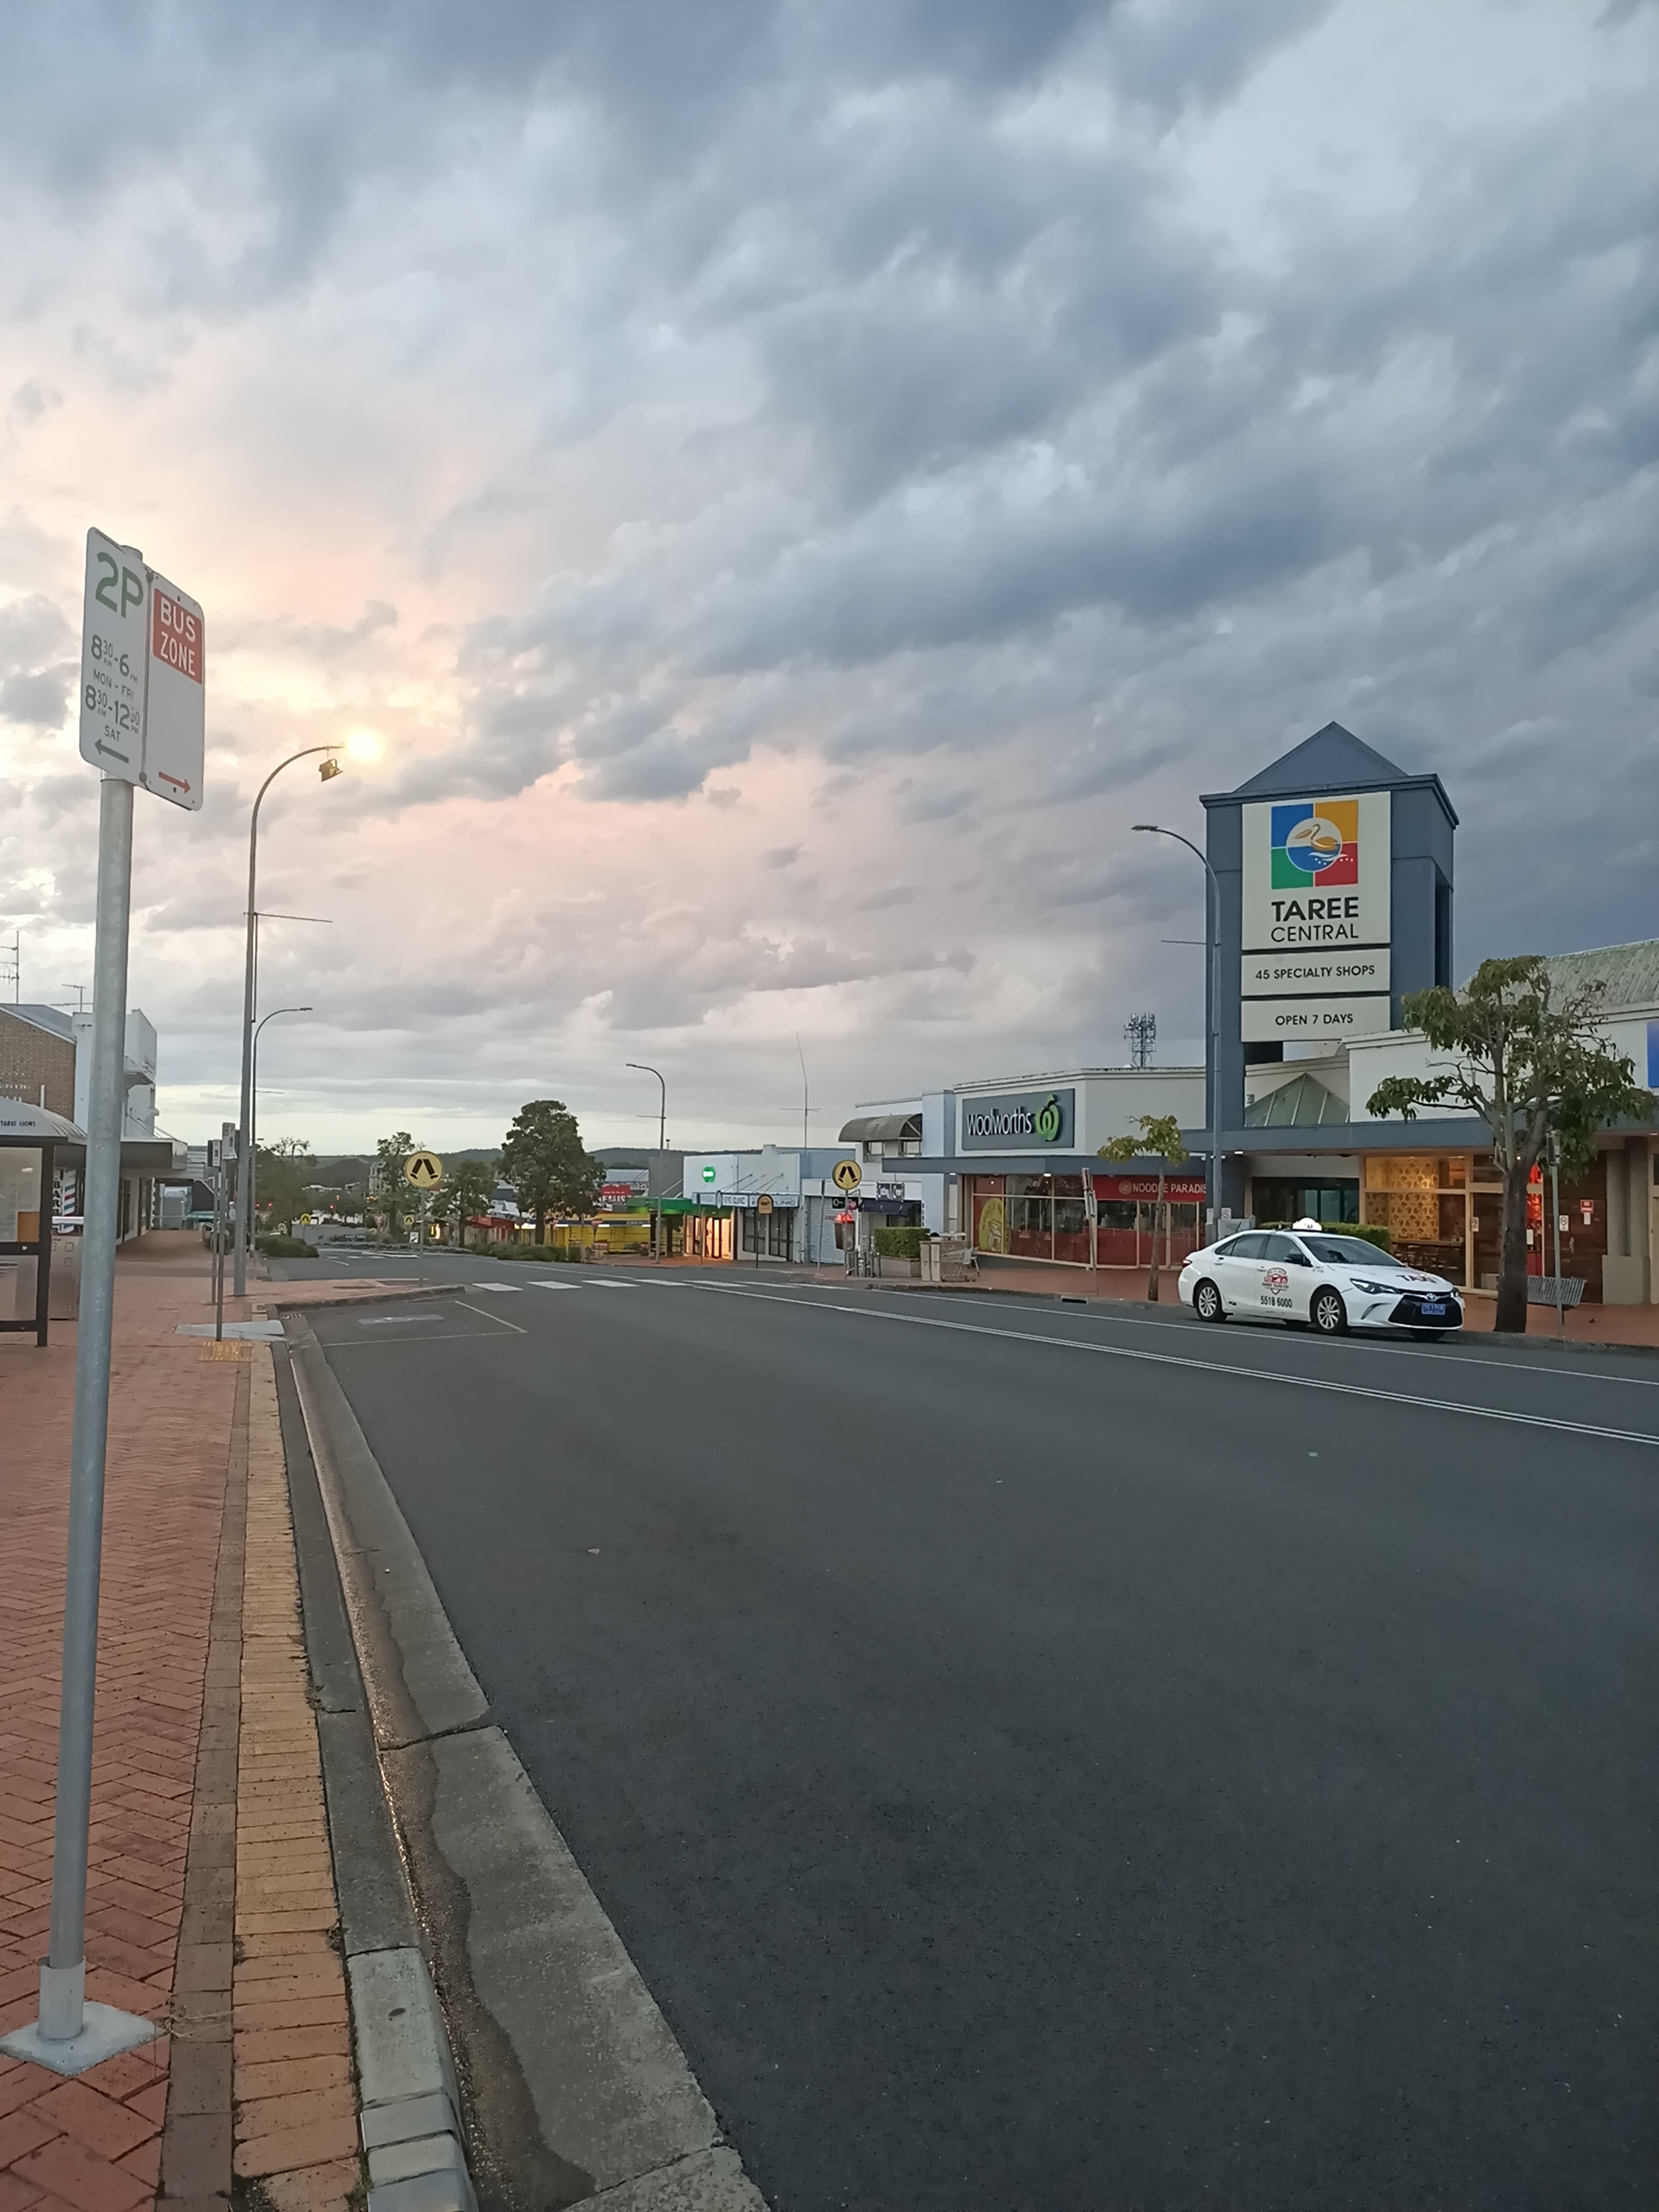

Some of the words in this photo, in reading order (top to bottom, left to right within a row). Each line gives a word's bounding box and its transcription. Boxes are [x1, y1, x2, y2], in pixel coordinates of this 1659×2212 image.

[96, 552, 144, 618] 2P
[161, 597, 195, 642] BUS
[160, 632, 195, 676] ZONE
[105, 725, 120, 742] SAT
[1271, 896, 1359, 922] TAREE
[1271, 923, 1359, 943] CENTRAL
[1255, 969, 1270, 979] 45
[1274, 967, 1333, 979] SPECIALTY
[1336, 965, 1375, 977] SHOPS
[1275, 1015, 1307, 1025] OPEN
[1313, 1015, 1319, 1024] 7
[1323, 1013, 1354, 1024] DAYS
[1133, 1183, 1168, 1193] NOODE
[1171, 1183, 1206, 1193] PARADIS
